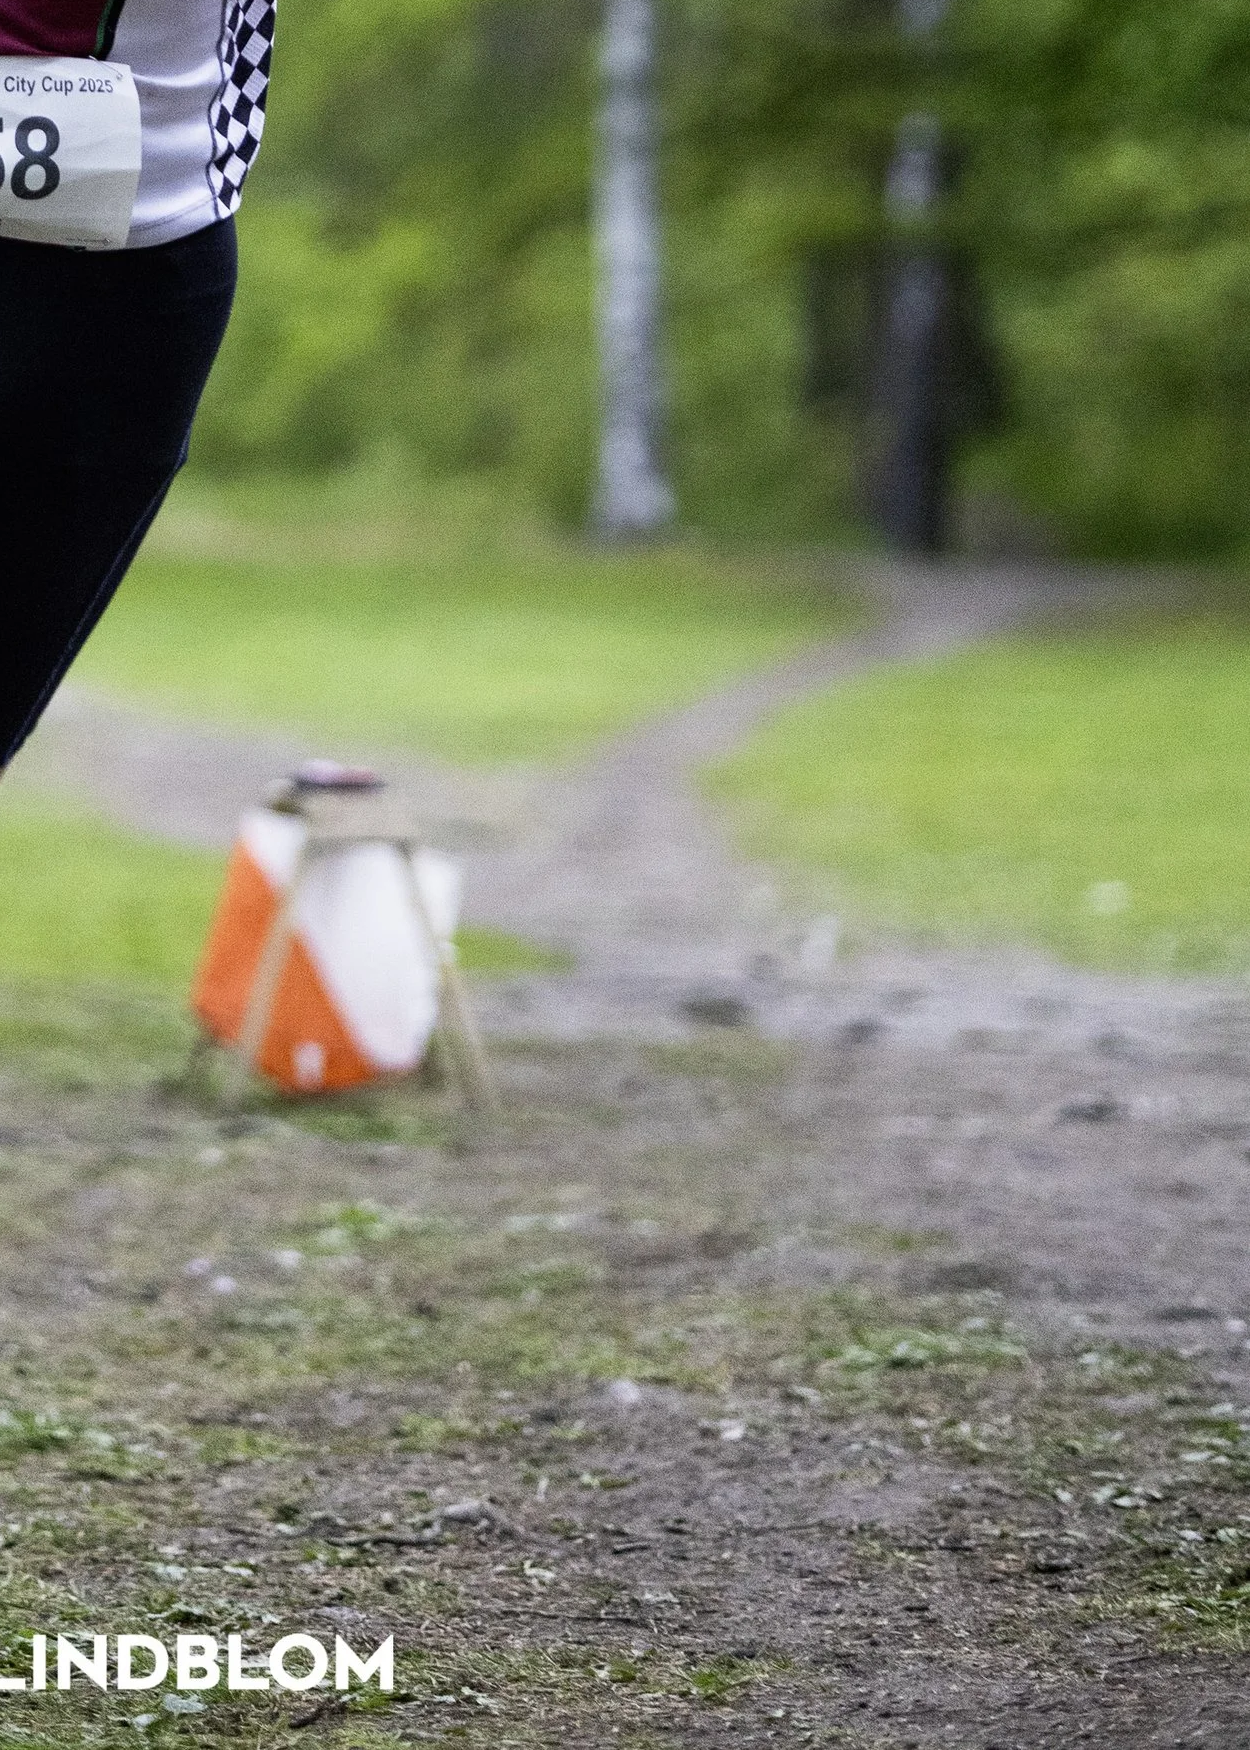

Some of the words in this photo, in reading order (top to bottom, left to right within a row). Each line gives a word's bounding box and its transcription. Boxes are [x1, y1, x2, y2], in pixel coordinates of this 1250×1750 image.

[3, 75, 36, 97] City
[41, 75, 74, 97] Cup
[78, 77, 114, 94] 2025
